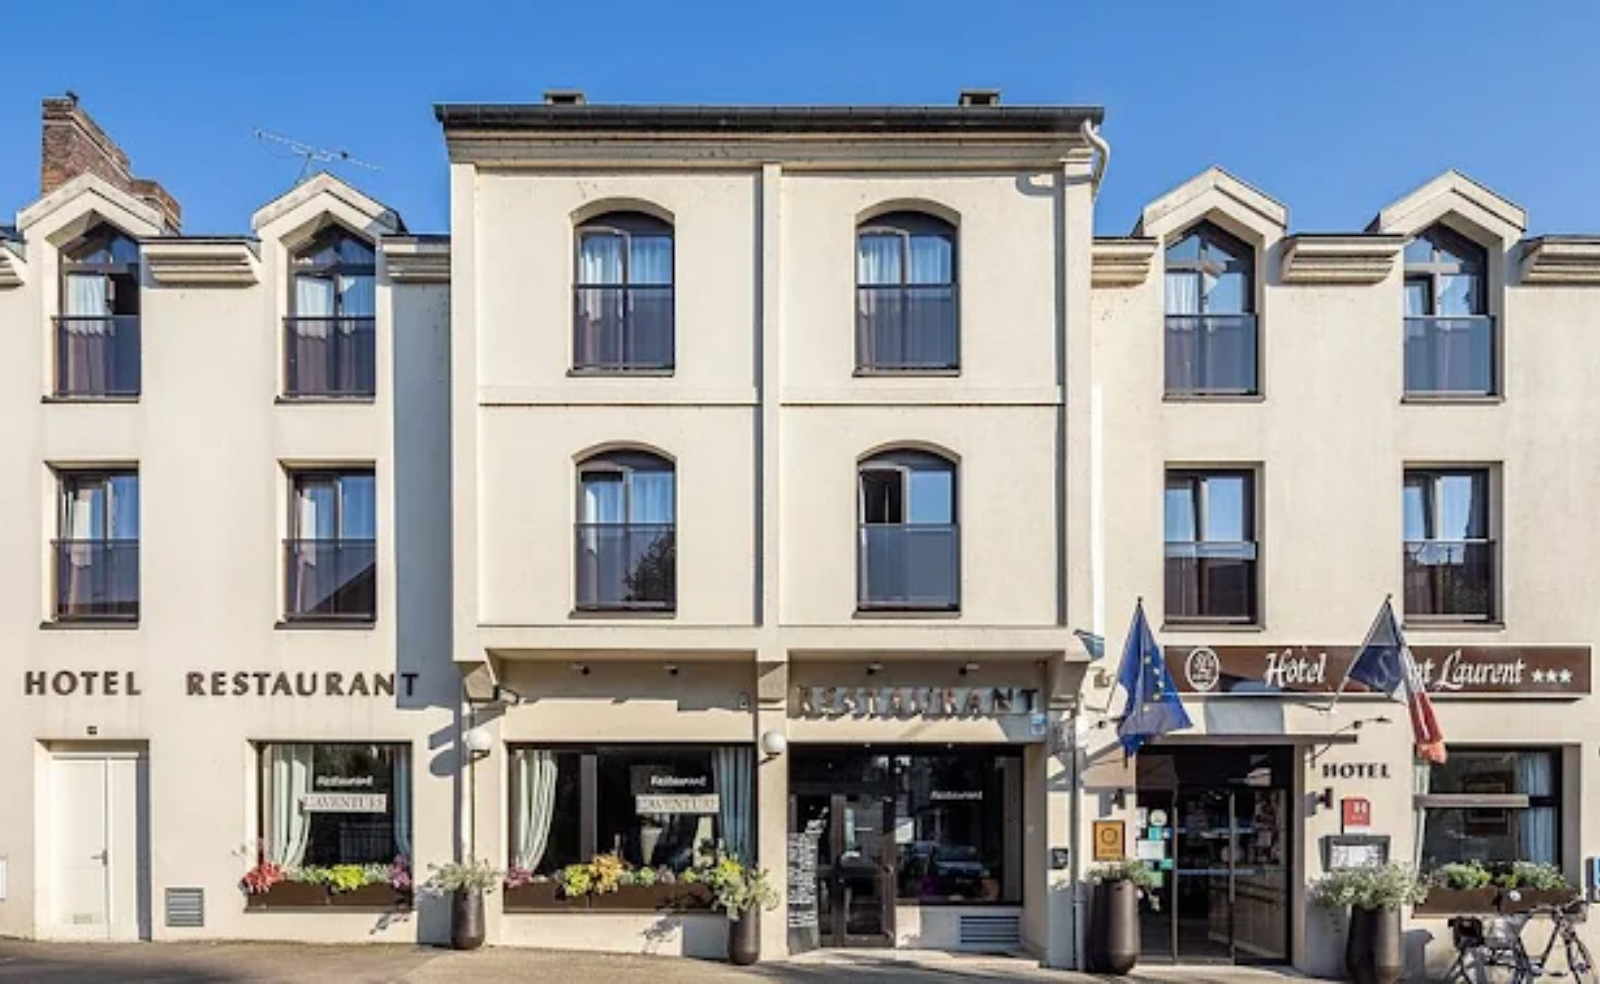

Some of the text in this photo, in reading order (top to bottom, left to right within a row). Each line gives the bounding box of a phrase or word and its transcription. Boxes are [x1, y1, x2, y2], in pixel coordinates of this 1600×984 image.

[1263, 648, 1327, 688] Hôtel
[1433, 649, 1526, 690] Laurent
[24, 671, 142, 696] HOTEL
[185, 671, 420, 697] RESTAURANT
[797, 686, 1039, 714] RESTAURANT
[1322, 763, 1392, 779] HOTEL
